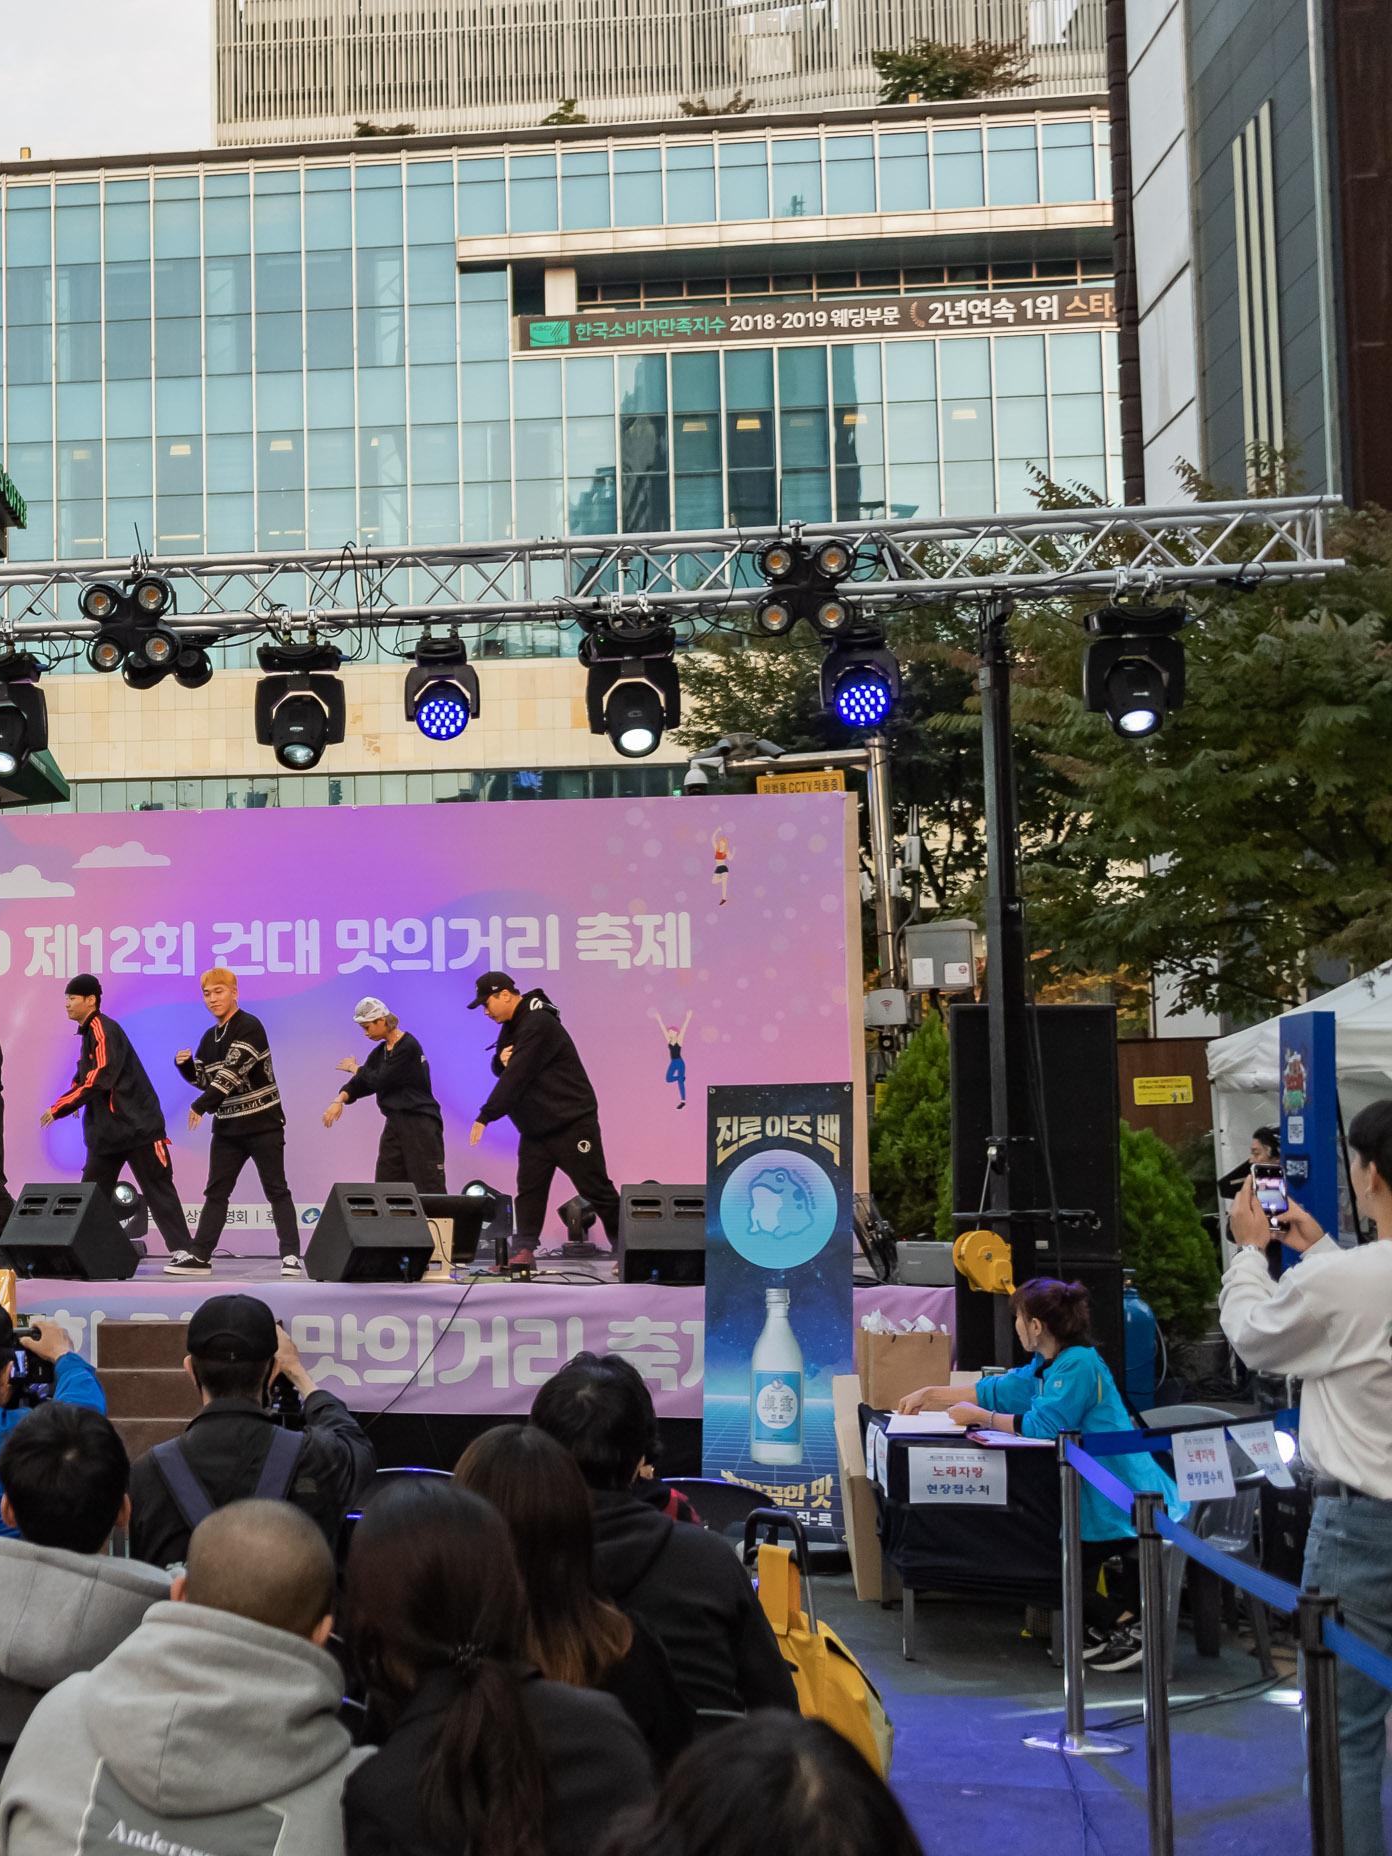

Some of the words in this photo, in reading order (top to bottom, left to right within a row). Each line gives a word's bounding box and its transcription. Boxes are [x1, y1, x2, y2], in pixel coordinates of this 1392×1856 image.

[574, 316, 726, 341] 한국소비자만족지수
[830, 305, 901, 328] 웨딩부문
[928, 297, 1017, 326] 2년연속
[1020, 294, 1058, 321] 1위
[1064, 293, 1118, 318] 스타
[788, 781, 812, 793] CCTV
[24, 920, 196, 979] 제12회
[211, 918, 321, 976] 건대
[335, 913, 561, 975] 맛의거리
[575, 911, 692, 970] 축제
[715, 1116, 762, 1167] 진로
[765, 1115, 813, 1145] 이즈
[817, 1114, 840, 1167] 백
[291, 1314, 584, 1389] 맛의거리
[1188, 1449, 1216, 1463] 노래자랑
[932, 1466, 984, 1478] 노래자랑
[1186, 1470, 1224, 1486] 현장접수처
[810, 1474, 833, 1509] 맛
[926, 1484, 990, 1495] 현장접수처
